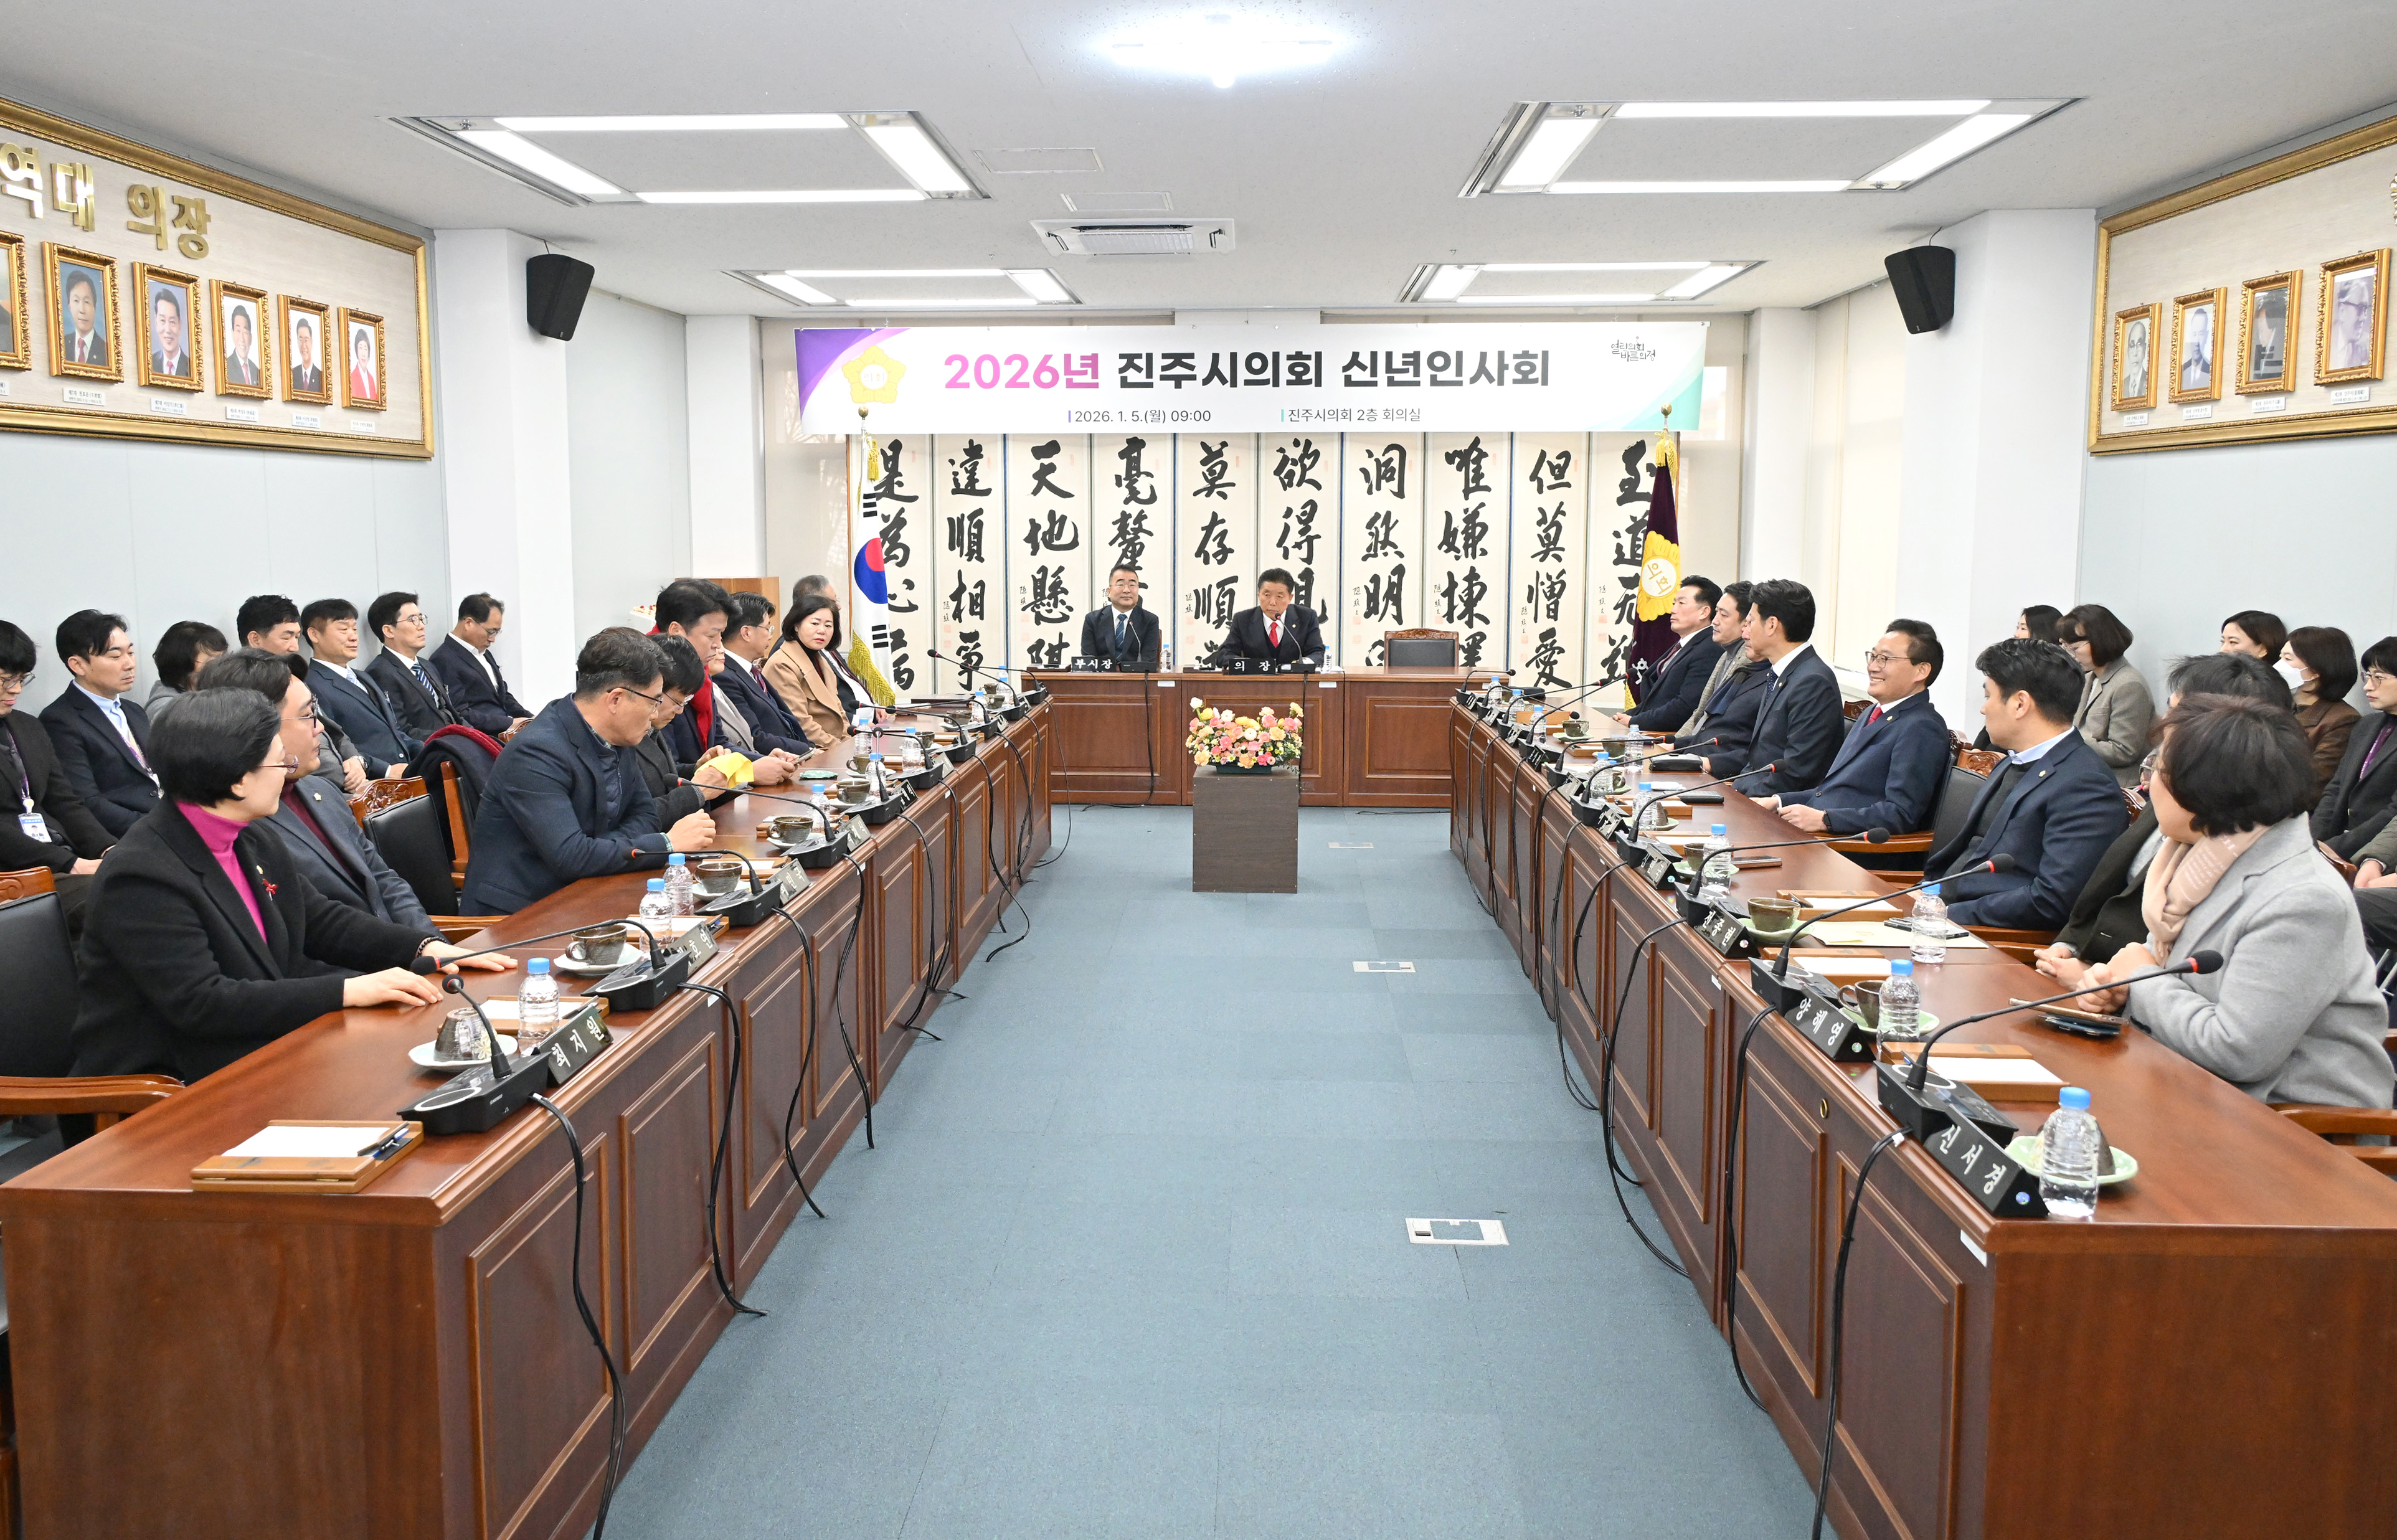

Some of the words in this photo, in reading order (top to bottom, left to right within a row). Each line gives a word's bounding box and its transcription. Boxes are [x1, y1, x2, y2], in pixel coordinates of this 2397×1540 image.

[0, 143, 95, 232] 역대
[127, 184, 211, 259] 의장
[944, 352, 1099, 389] 2026년
[1118, 350, 1322, 389] 진주시의회
[1341, 349, 1549, 387] 신년인사회
[1075, 410, 1113, 422] 2026.
[1118, 410, 1127, 422] 1.
[1171, 410, 1211, 422] 09:00
[1288, 408, 1351, 422] 진주시의회
[1357, 409, 1378, 422] 2층
[1383, 408, 1421, 422] 회의실
[1647, 562, 1672, 595] 의회
[1074, 658, 1113, 669] 부시장
[1702, 910, 1736, 947] 전종현
[1795, 998, 1845, 1046] 양해영
[551, 1016, 605, 1068] 최지원
[1939, 1124, 2007, 1194] 신서경
